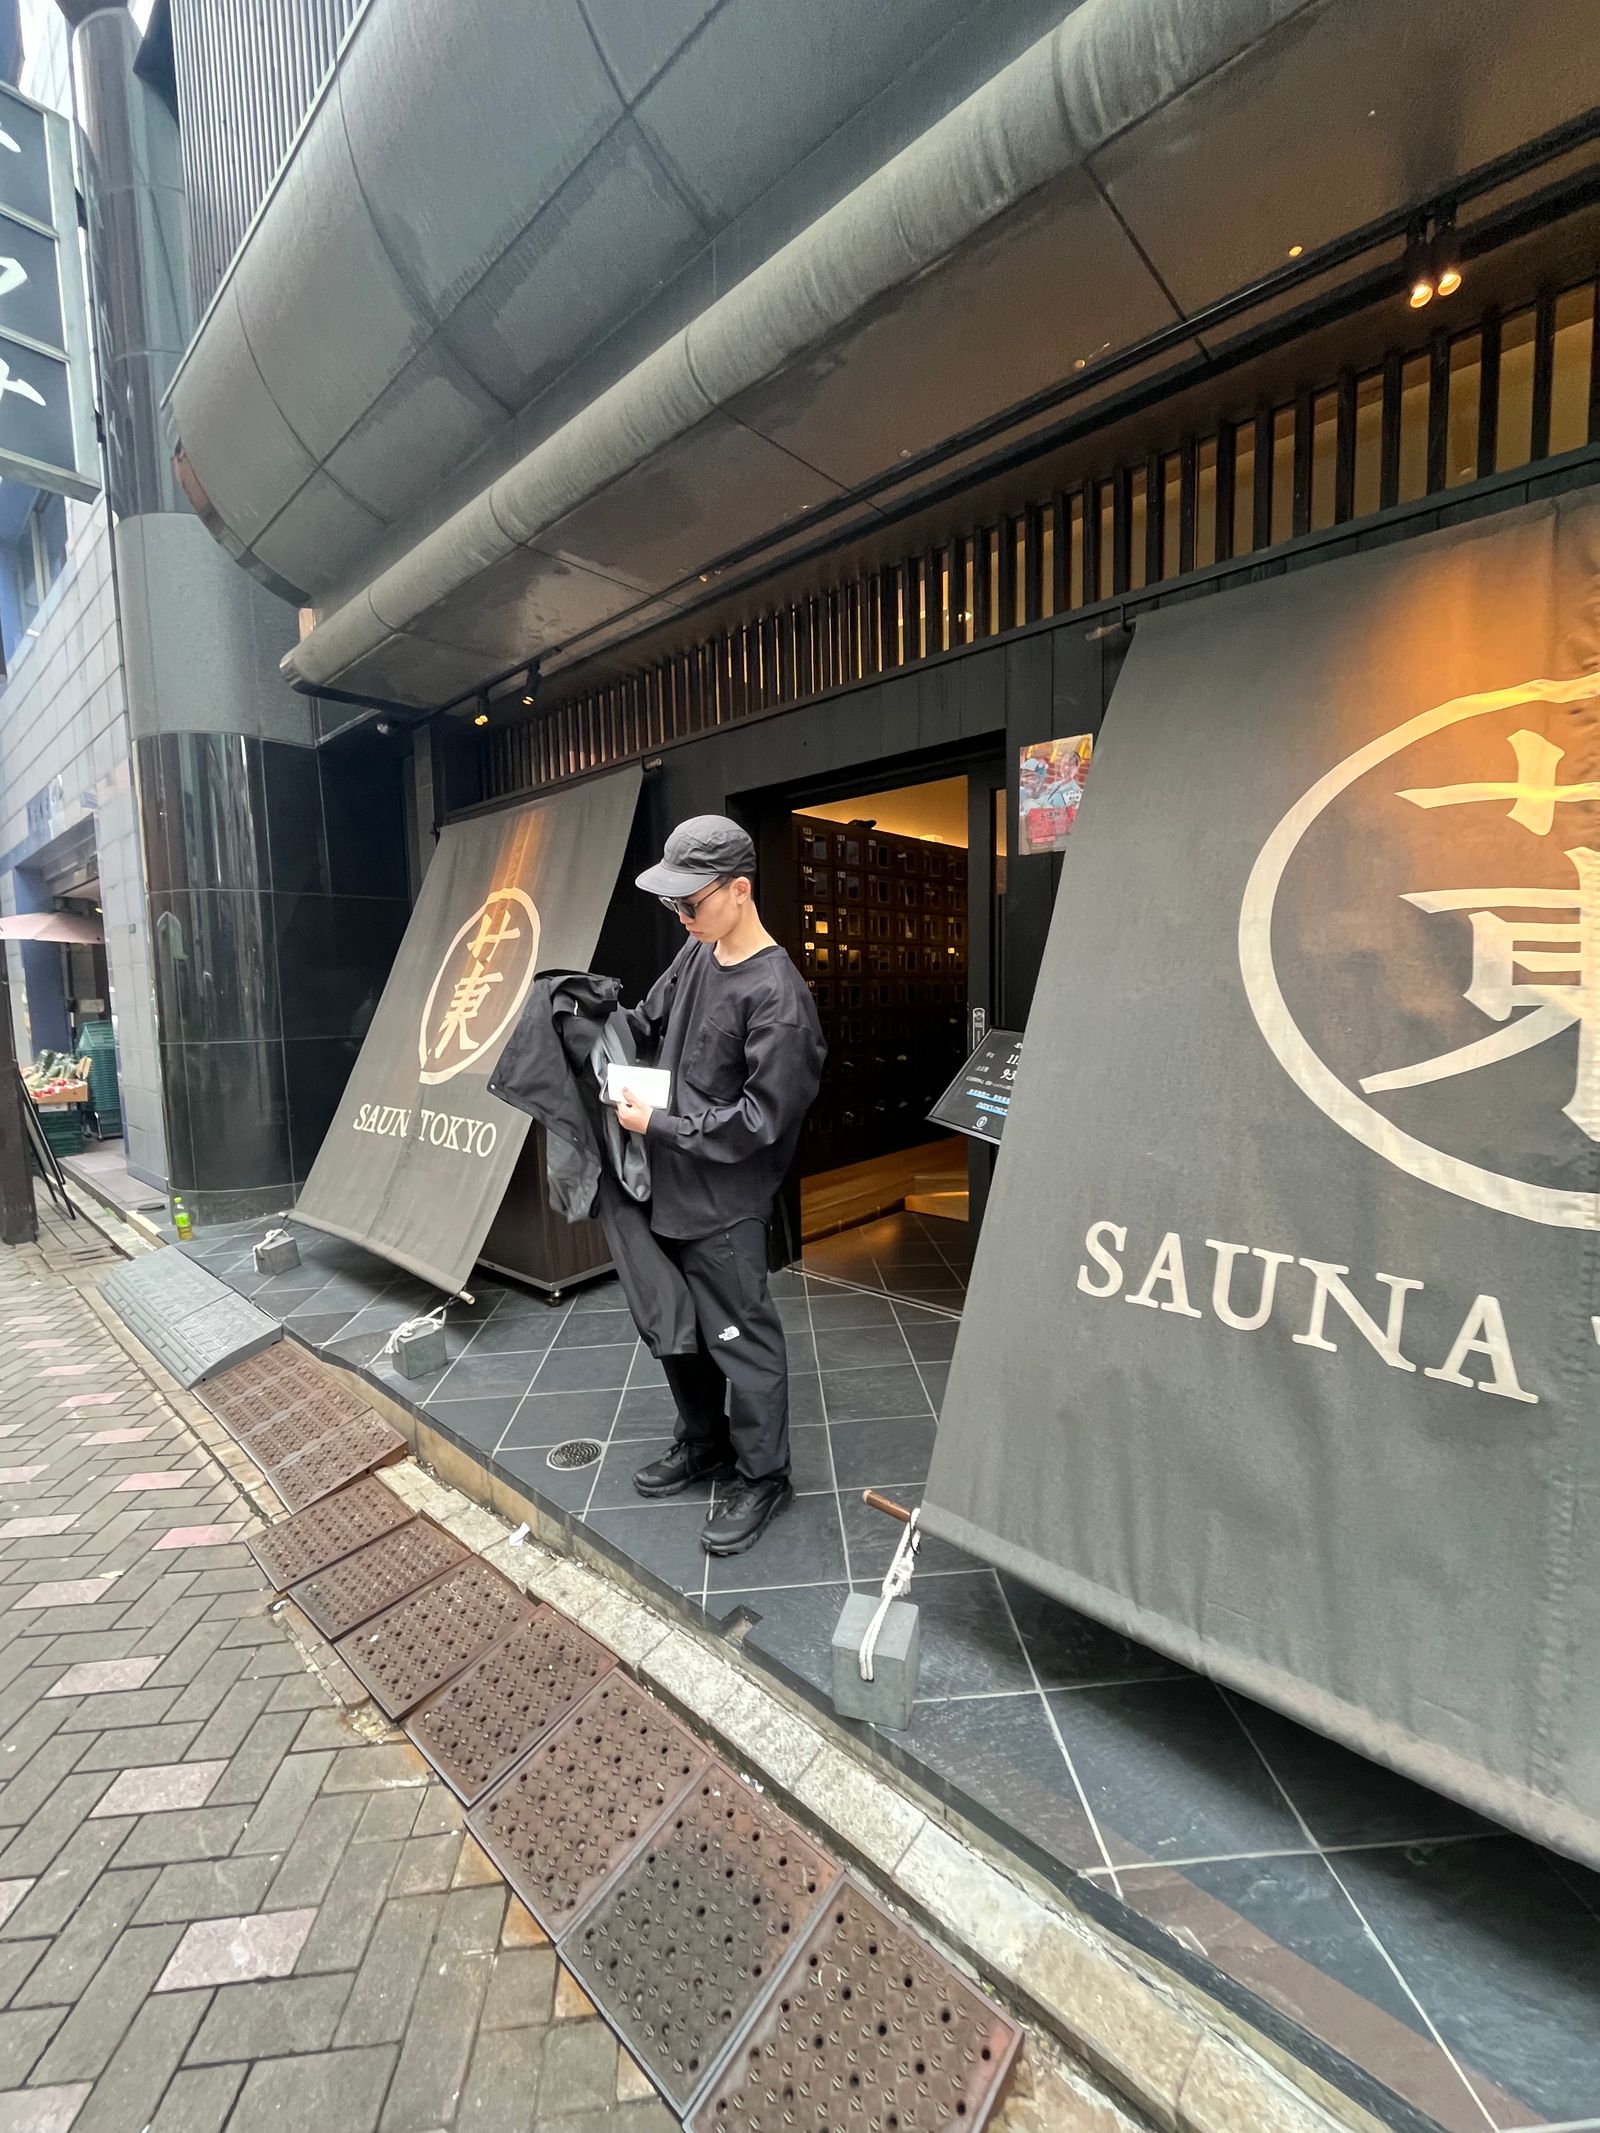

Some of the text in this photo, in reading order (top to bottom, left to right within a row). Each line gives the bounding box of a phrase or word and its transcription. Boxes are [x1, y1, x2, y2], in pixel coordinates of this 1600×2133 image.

[353, 1103, 497, 1158] SAUN TOKYO
[1076, 1220, 1540, 1405] SAUNA
